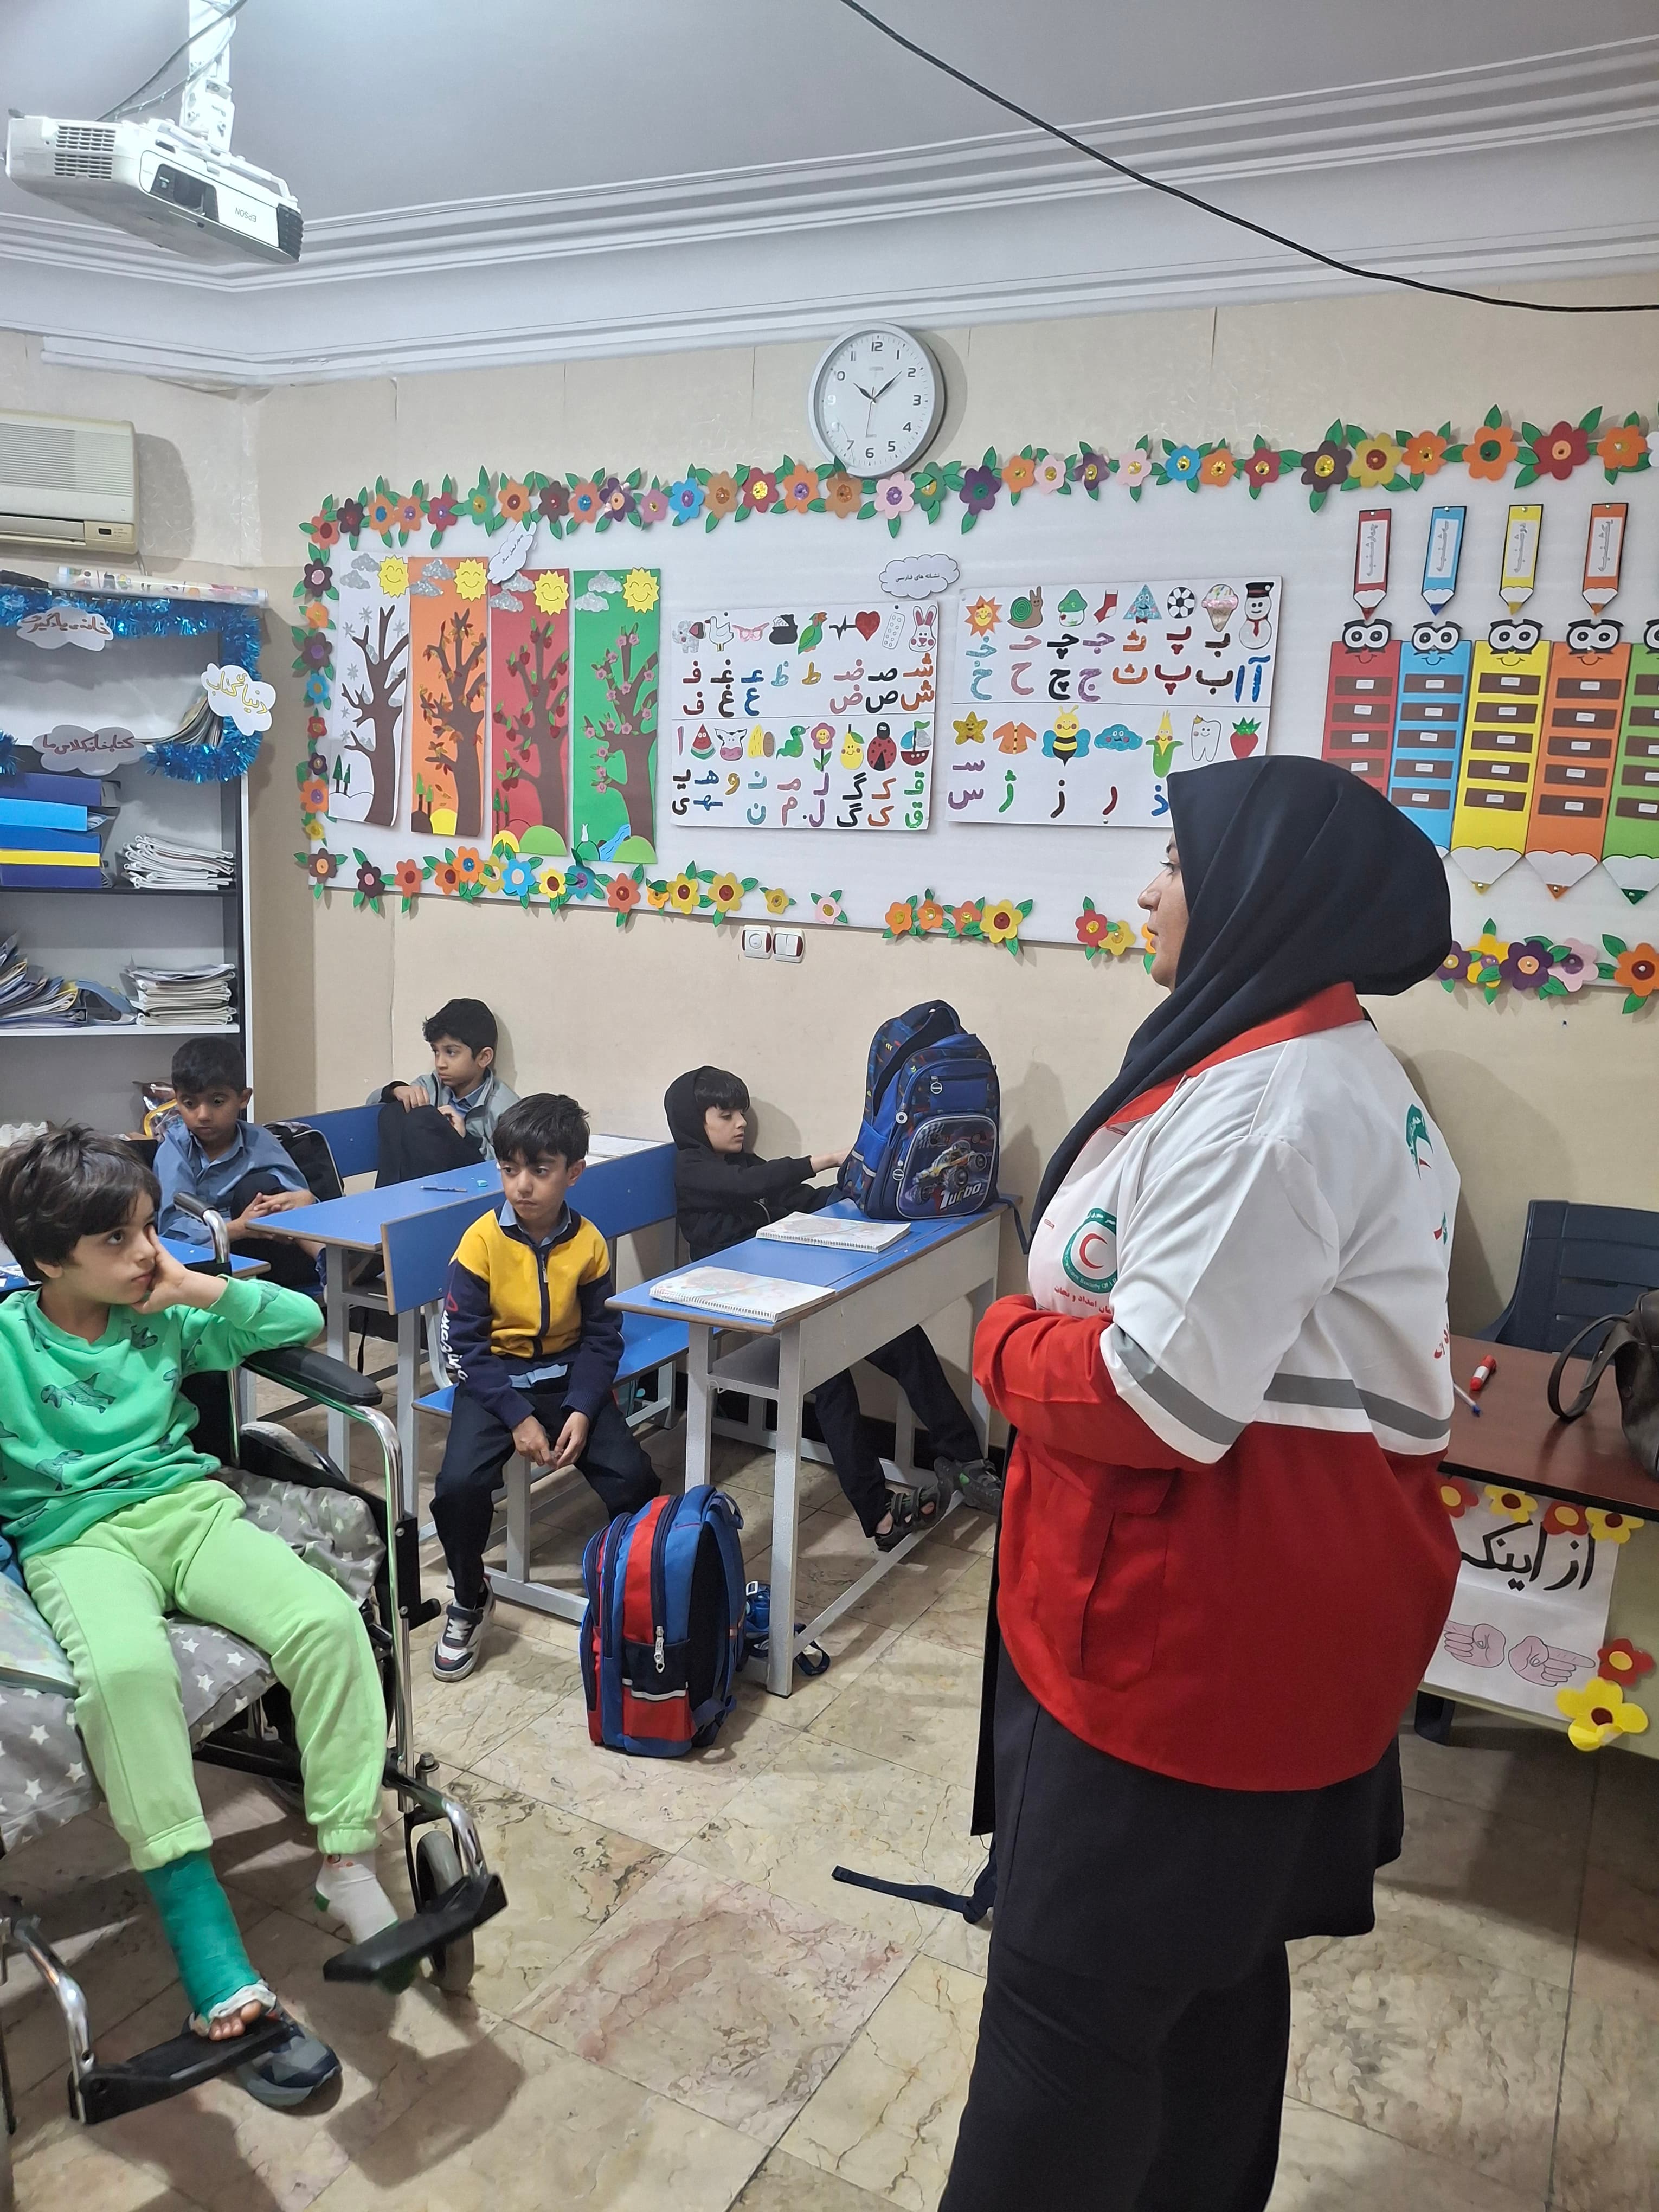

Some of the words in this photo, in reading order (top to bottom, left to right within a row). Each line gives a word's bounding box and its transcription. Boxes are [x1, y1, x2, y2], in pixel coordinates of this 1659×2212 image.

[235, 207, 256, 222] EPSON
[871, 341, 883, 352] 12
[896, 349, 900, 360] 1
[907, 368, 916, 378] 2
[913, 395, 922, 406] 3
[903, 422, 912, 432] 4
[847, 440, 855, 451] 7
[888, 440, 896, 452] 5
[865, 448, 874, 459] 6
[895, 574, 913, 582] فارسی
[206, 671, 244, 697] کتاب
[43, 734, 56, 748] ما
[940, 1182, 982, 1210] Turbo
[1543, 1530, 1596, 1591] از
